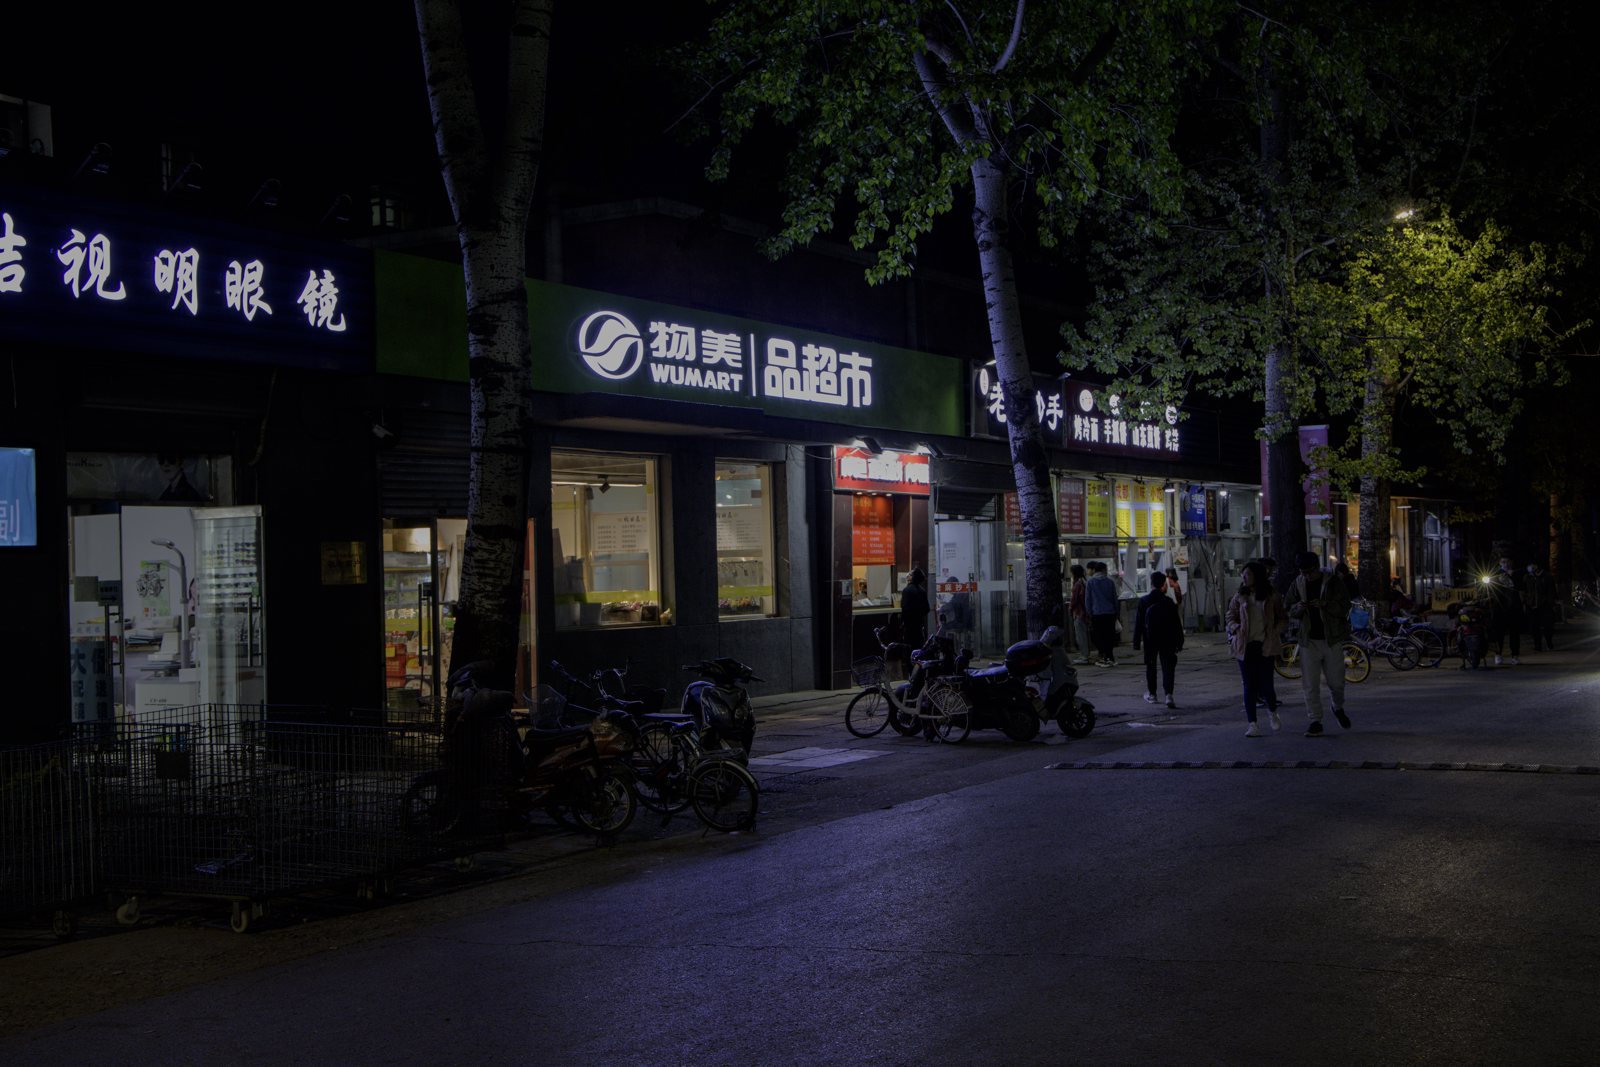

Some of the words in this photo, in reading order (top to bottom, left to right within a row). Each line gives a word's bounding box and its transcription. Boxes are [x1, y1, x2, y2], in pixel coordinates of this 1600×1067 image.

[649, 320, 743, 369] 物美
[764, 337, 873, 408] 品超市
[650, 361, 744, 393] WUMART
